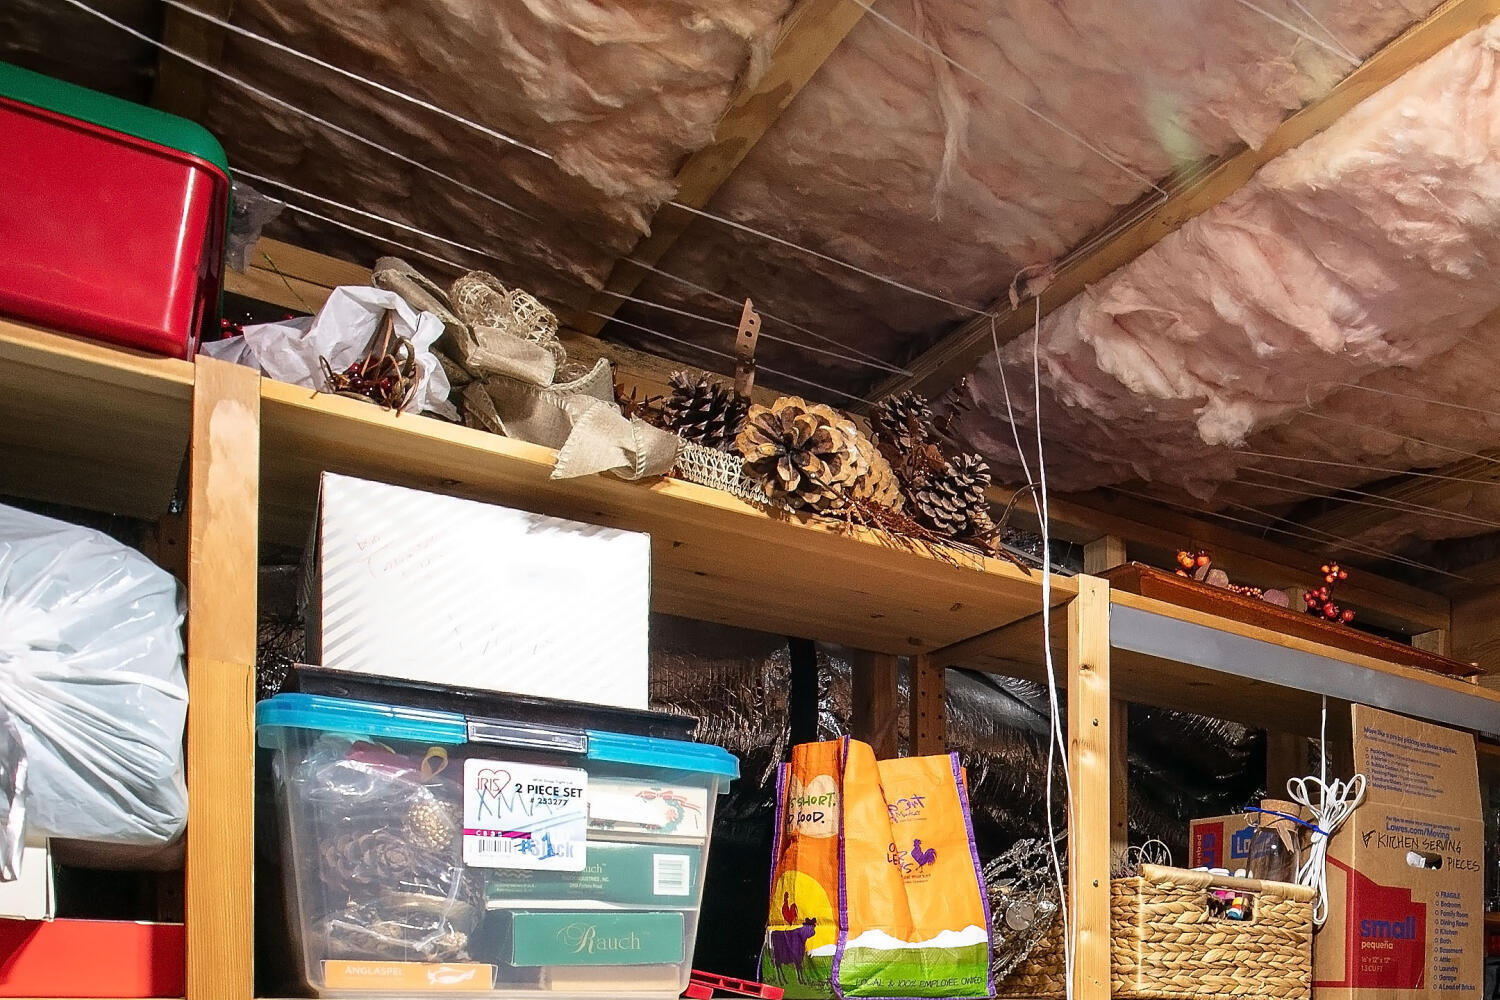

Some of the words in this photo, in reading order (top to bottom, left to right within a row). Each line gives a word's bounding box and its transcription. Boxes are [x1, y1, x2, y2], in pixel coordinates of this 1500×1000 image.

[477, 777, 501, 792] IRIS
[515, 783, 523, 794] 2
[527, 784, 560, 796] PIECE
[563, 787, 583, 798] SET
[1386, 821, 1451, 840] Lowes.com/Moving
[1422, 839, 1462, 854] SERVING
[1446, 857, 1480, 872] PIECES
[1361, 915, 1417, 940] small
[556, 922, 641, 954] Rauch
[920, 977, 958, 987] EMPLOYEE
